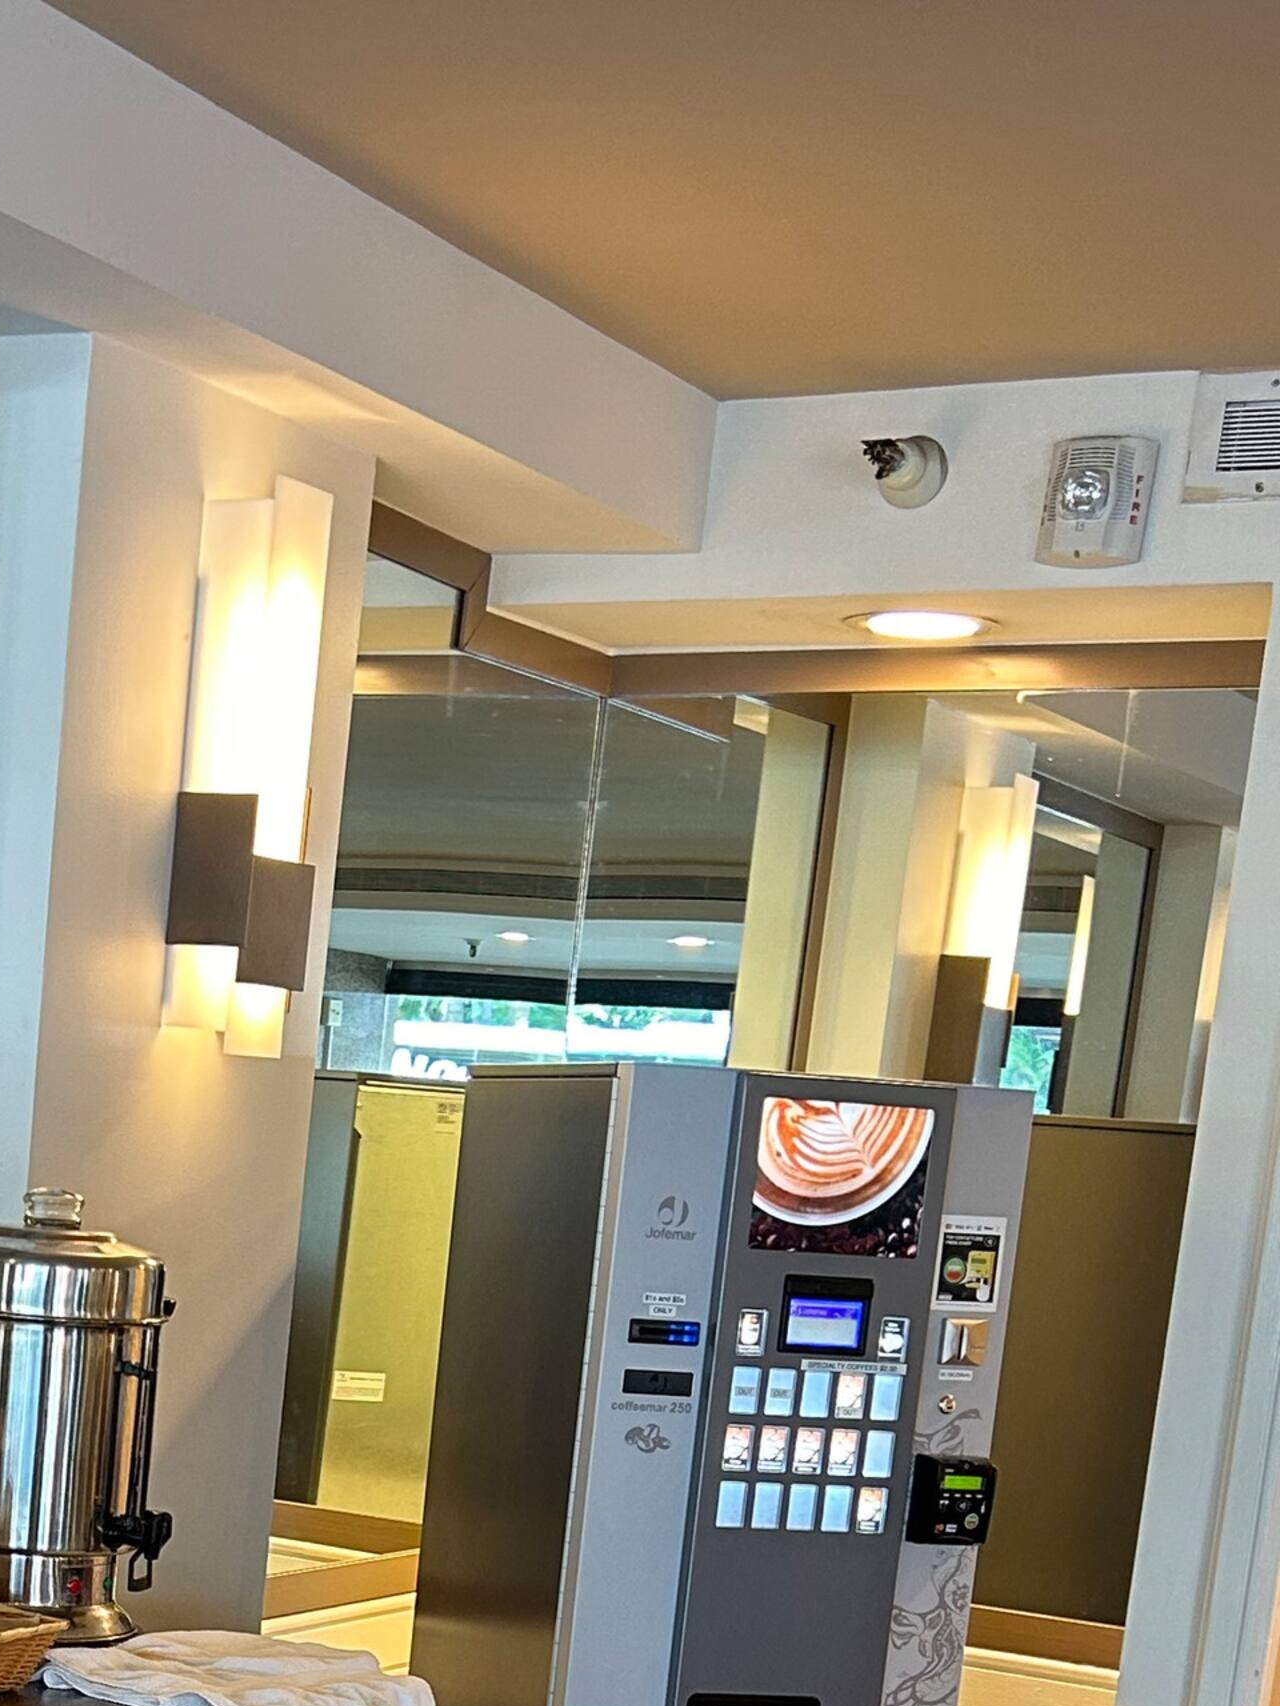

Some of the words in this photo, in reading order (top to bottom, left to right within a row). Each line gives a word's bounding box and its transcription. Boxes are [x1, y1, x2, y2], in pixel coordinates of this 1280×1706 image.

[1129, 474, 1145, 525] FIRE
[644, 1226, 697, 1241] Jofemar
[653, 1306, 673, 1314] ONLY
[807, 1362, 845, 1370] SPECIALTY
[846, 1363, 877, 1371] COFFEES
[737, 1387, 754, 1396] OUT
[610, 1401, 668, 1413] coffeemar
[669, 1402, 693, 1414] 250
[842, 1408, 857, 1416] OUT
